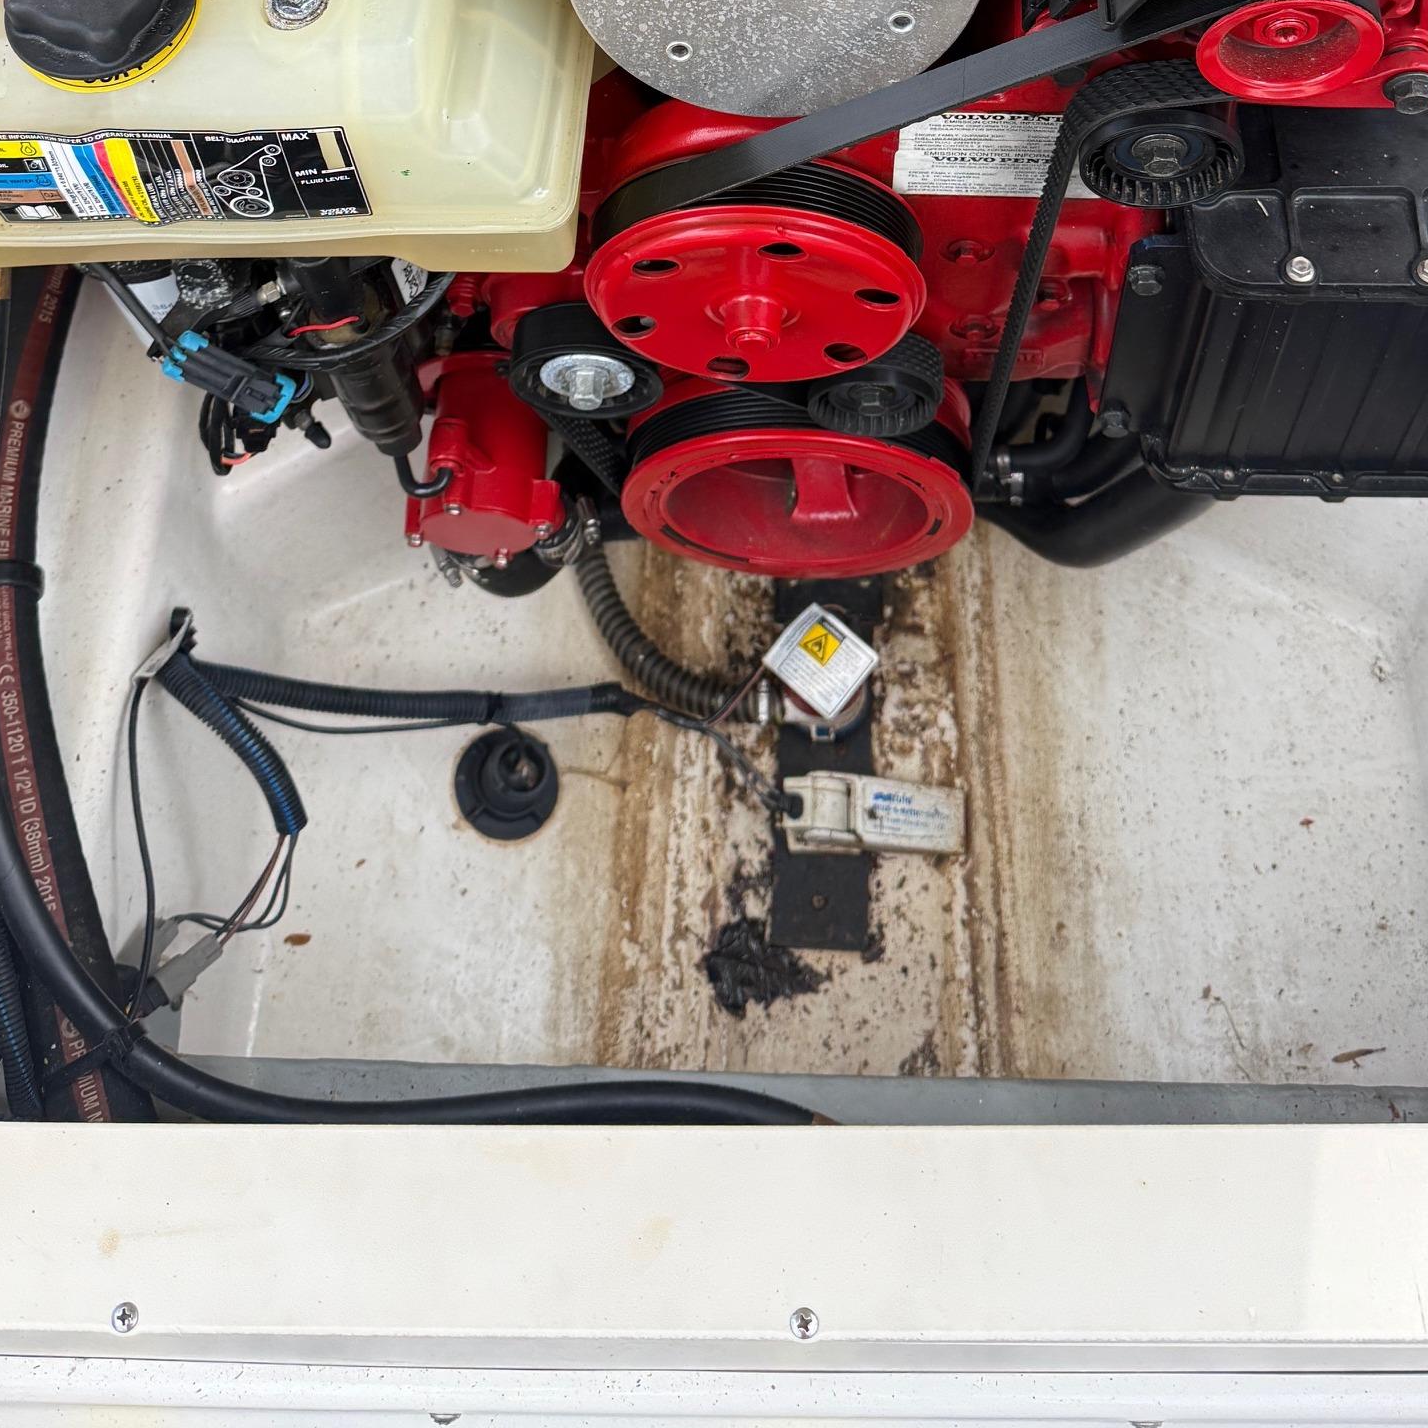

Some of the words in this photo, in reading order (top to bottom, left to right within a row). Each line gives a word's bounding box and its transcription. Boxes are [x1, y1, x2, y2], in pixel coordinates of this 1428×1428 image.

[8, 134, 57, 142] INFORMATION
[57, 136, 82, 144] REFER
[94, 131, 141, 140] OPERATOR'S
[225, 135, 263, 143] DIAGRAM
[281, 133, 309, 141] MAX
[295, 168, 318, 177] MIN
[300, 177, 324, 185] FLUID
[324, 175, 350, 183] LEVEL
[37, 293, 59, 323] 2015
[1, 420, 25, 483] PREMIUM
[0, 689, 26, 753] 350-1120
[20, 796, 39, 814] ID
[20, 816, 52, 873] (38mm)
